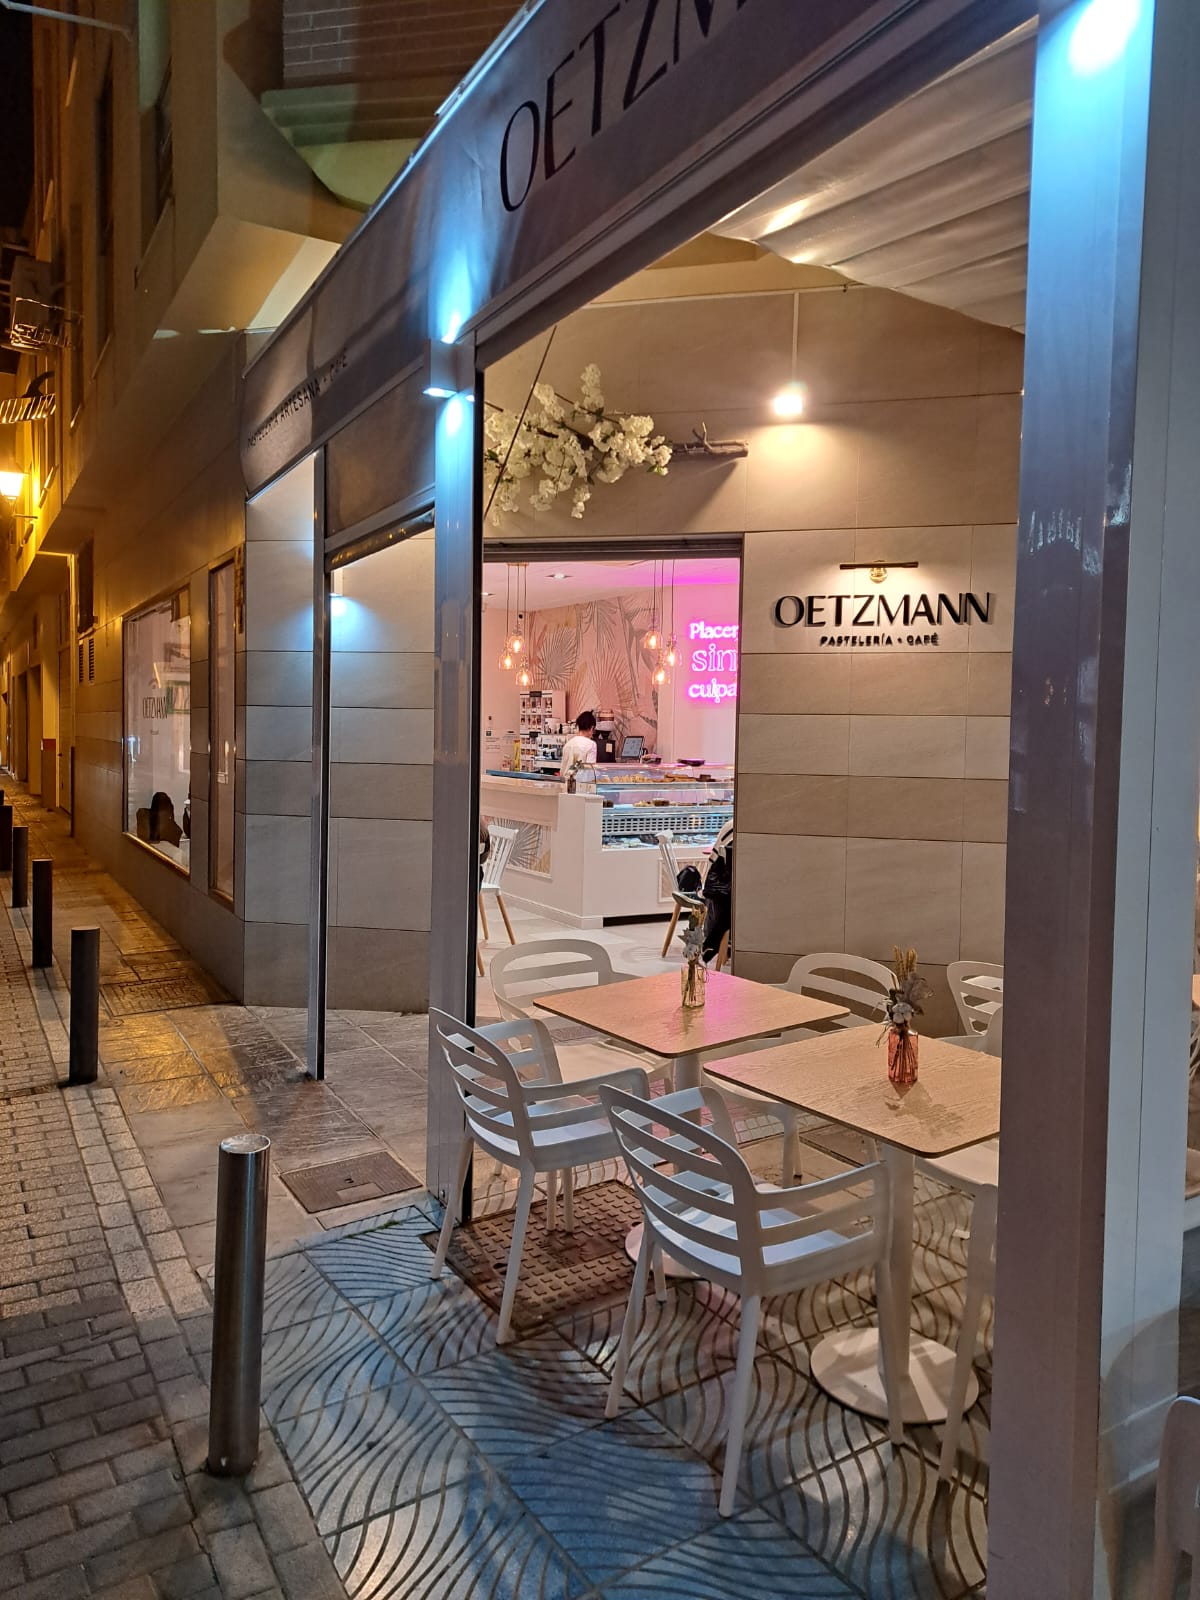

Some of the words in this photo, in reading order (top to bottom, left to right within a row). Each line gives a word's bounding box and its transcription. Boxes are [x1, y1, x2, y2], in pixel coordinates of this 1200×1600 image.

[280, 378, 321, 423] ARTESANA
[774, 592, 990, 627] OETZMANN
[689, 621, 738, 639] Placer
[820, 633, 893, 647] PASTELERÍA
[906, 632, 940, 647] CAFÉ
[691, 643, 737, 672] sin
[688, 678, 737, 703] culpa
